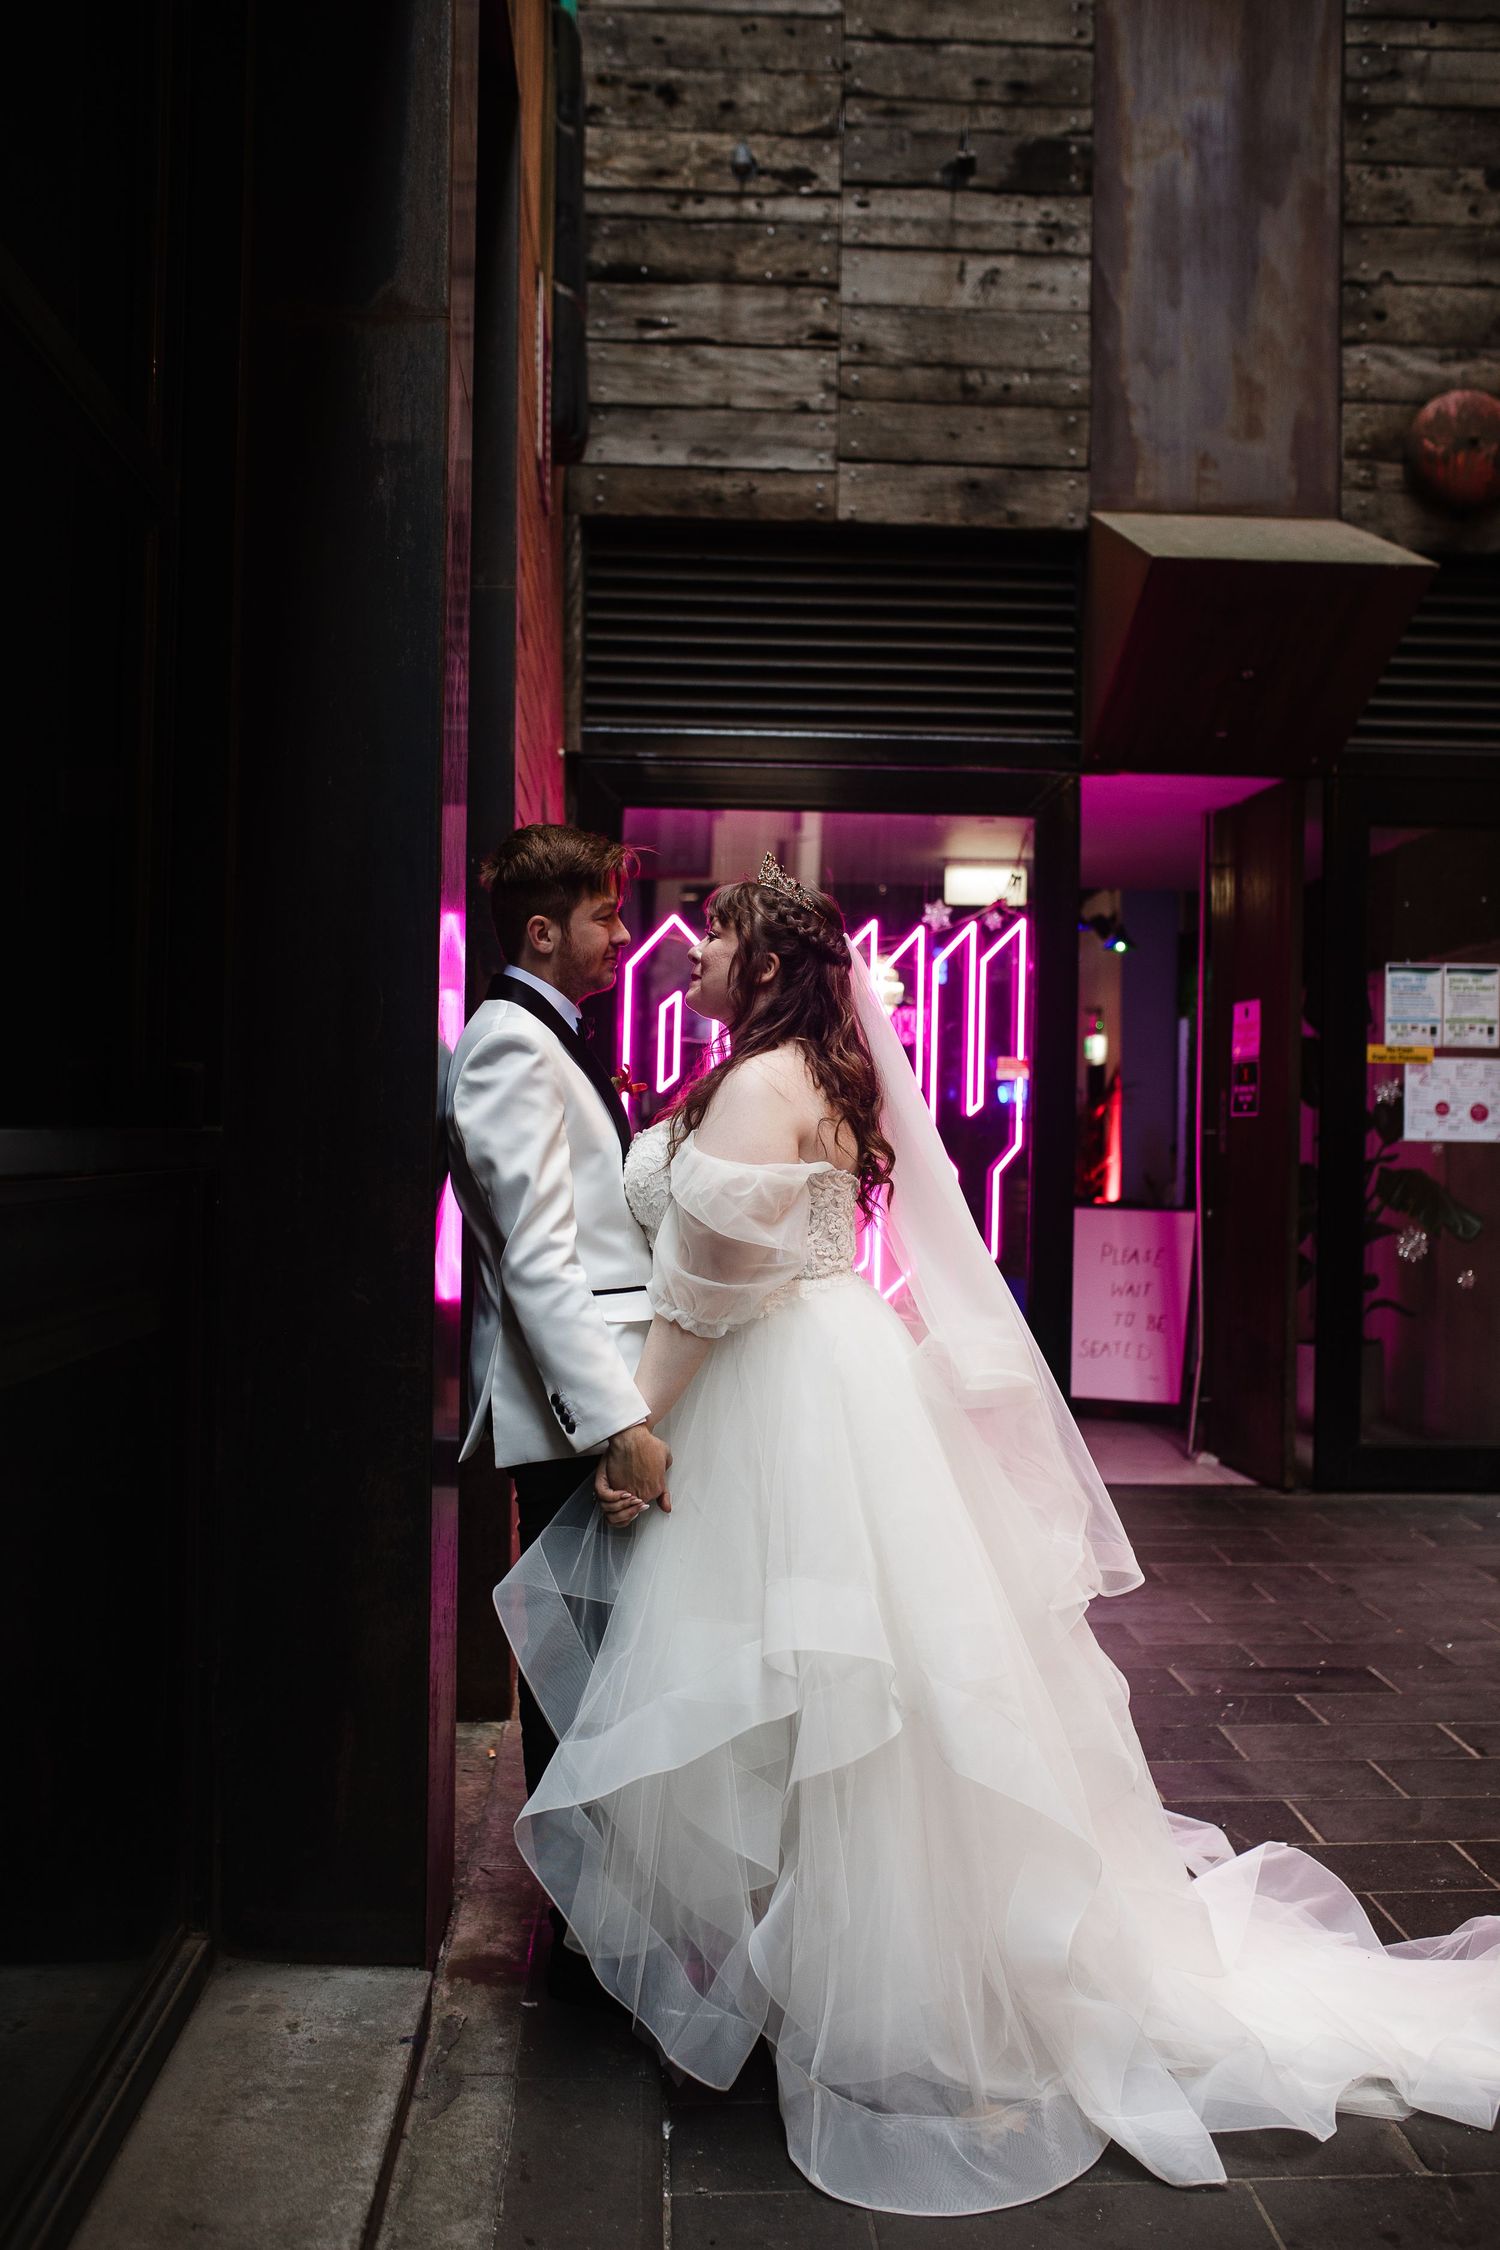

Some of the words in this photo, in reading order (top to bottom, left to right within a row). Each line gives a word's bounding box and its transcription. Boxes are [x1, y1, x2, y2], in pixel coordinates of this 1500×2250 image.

[1101, 1242, 1165, 1268] PLEASE
[1111, 1281, 1152, 1298] WAIT
[1113, 1311, 1136, 1328] TO
[1146, 1313, 1168, 1334] BE
[1078, 1338, 1152, 1362] SEATED
